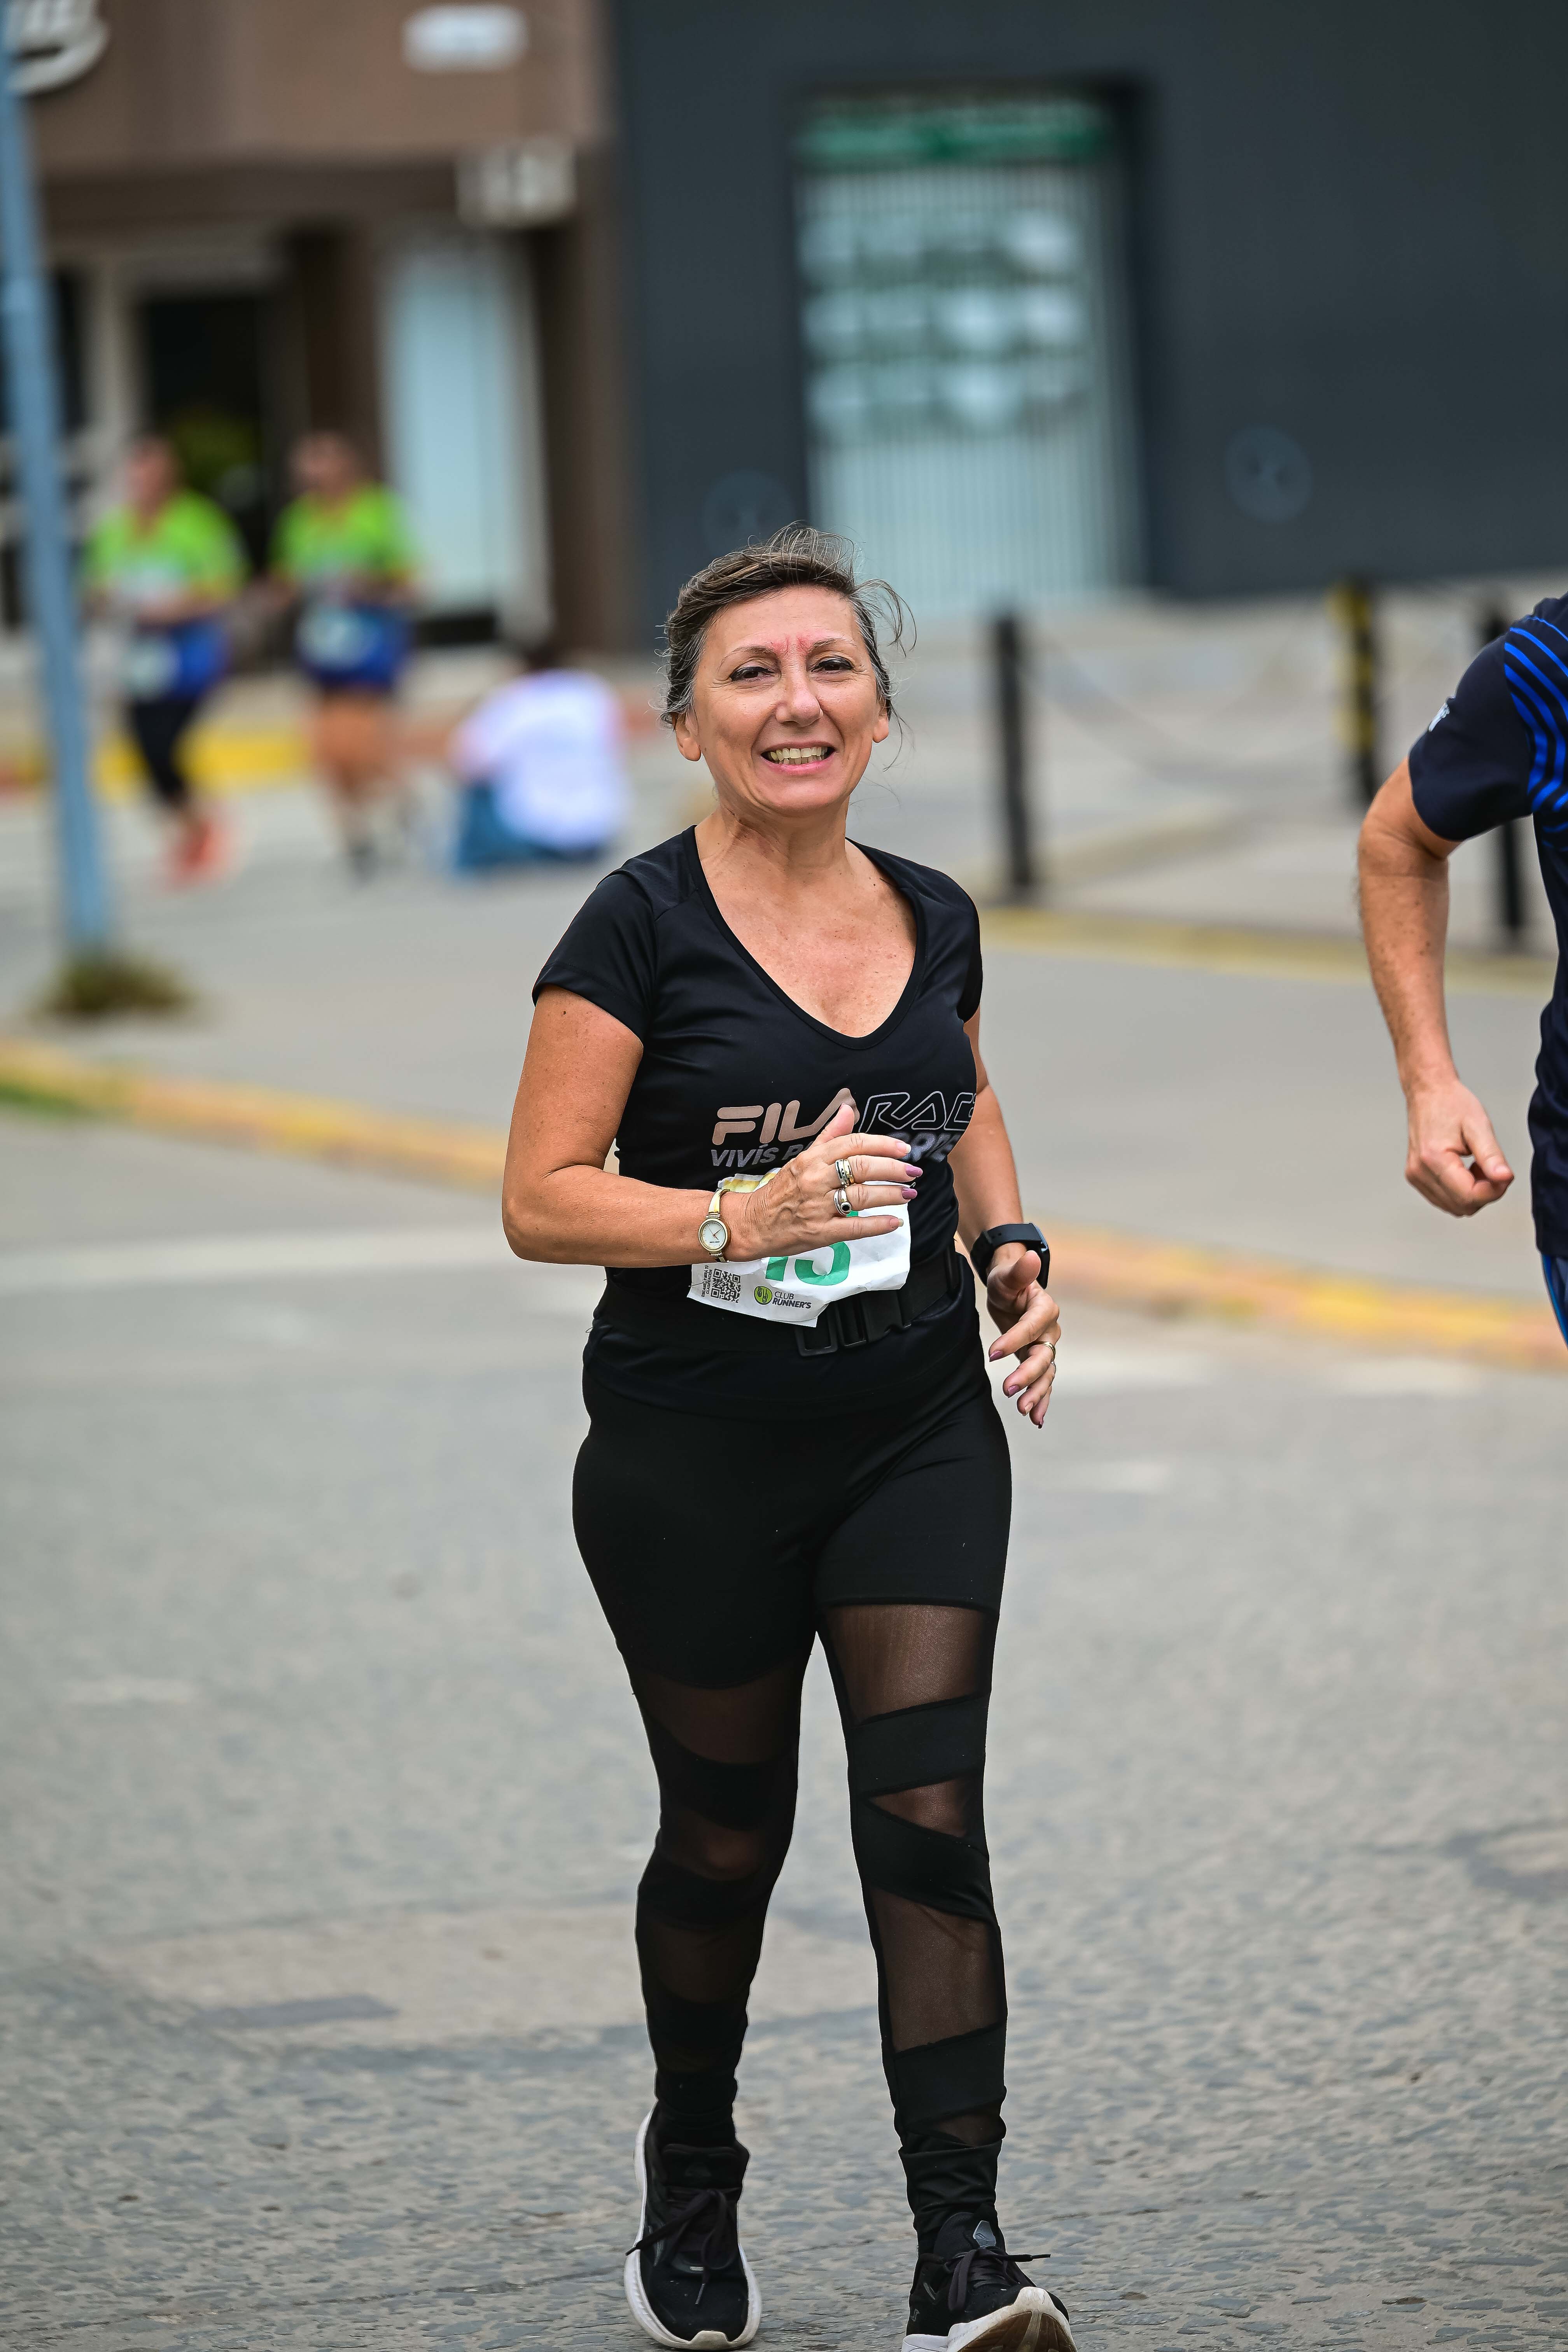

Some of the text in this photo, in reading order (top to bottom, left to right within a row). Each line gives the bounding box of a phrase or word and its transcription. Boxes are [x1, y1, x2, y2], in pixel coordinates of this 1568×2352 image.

[712, 1088, 976, 1145] FILA RAC
[711, 1143, 779, 1167] VIVÍS
[772, 1297, 812, 1309] RUNNER'S
[774, 1291, 794, 1300] CLUB
